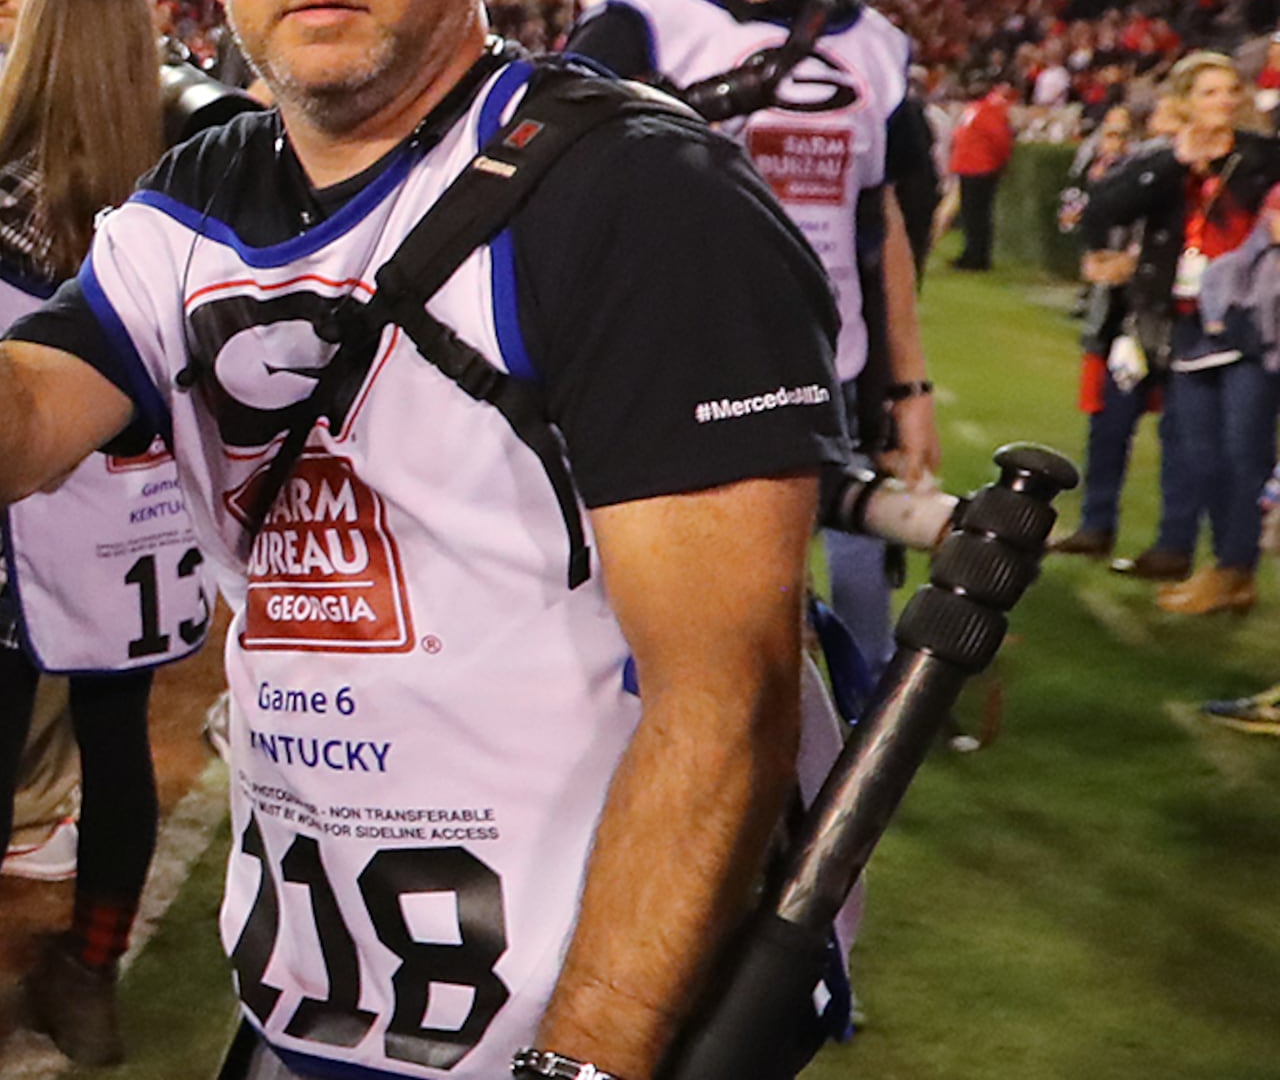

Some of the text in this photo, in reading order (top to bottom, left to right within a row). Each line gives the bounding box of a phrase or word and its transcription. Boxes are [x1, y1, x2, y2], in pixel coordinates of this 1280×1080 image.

[265, 477, 358, 523] ARM
[248, 527, 369, 576] UREAU
[258, 682, 355, 715] Game 6
[329, 806, 361, 820] NON
[365, 807, 496, 822] TRANSFERABLE
[355, 824, 427, 840] SIDELINE
[431, 826, 500, 841] ACCESS
[230, 808, 512, 1072] 118
